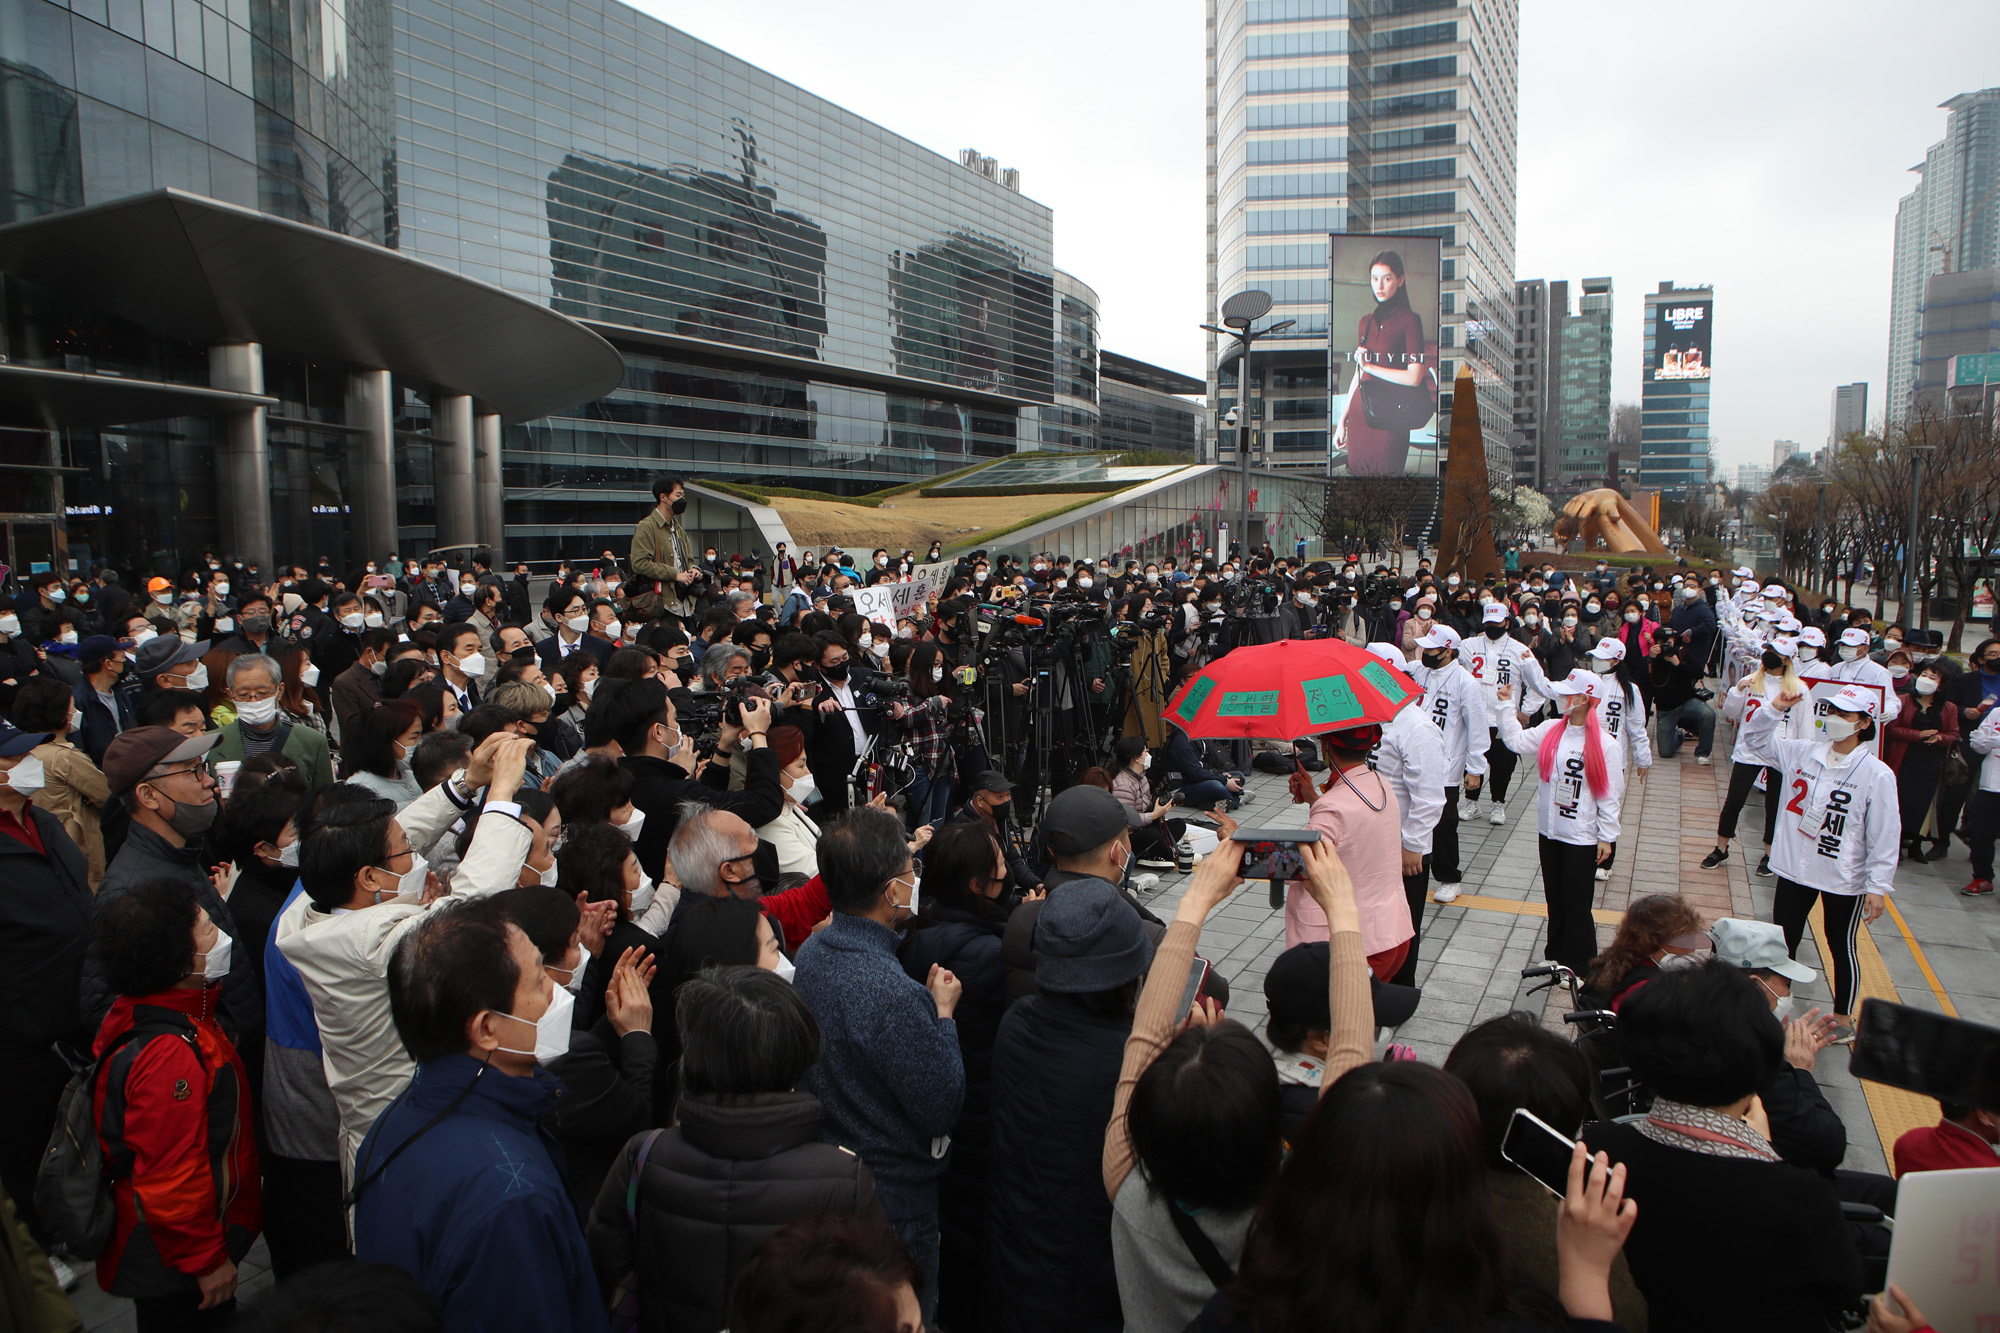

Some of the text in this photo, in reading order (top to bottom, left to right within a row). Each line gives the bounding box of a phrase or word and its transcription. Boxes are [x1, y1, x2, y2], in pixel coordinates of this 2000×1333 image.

[1664, 306, 1704, 322] LIBRE
[1345, 351, 1382, 363] TOUT
[1386, 352, 1396, 363] Y
[319, 504, 339, 514] Bran
[1444, 639, 1452, 648] 2
[1617, 650, 1623, 658] 2
[1471, 656, 1484, 679] 2
[1496, 658, 1511, 687] 오세
[1585, 684, 1594, 695] 2
[1308, 683, 1353, 717] 정의
[1867, 702, 1875, 714] 2
[1605, 701, 1622, 740] 오세
[1786, 778, 1808, 817] 2
[1817, 789, 1852, 860] 오세훈
